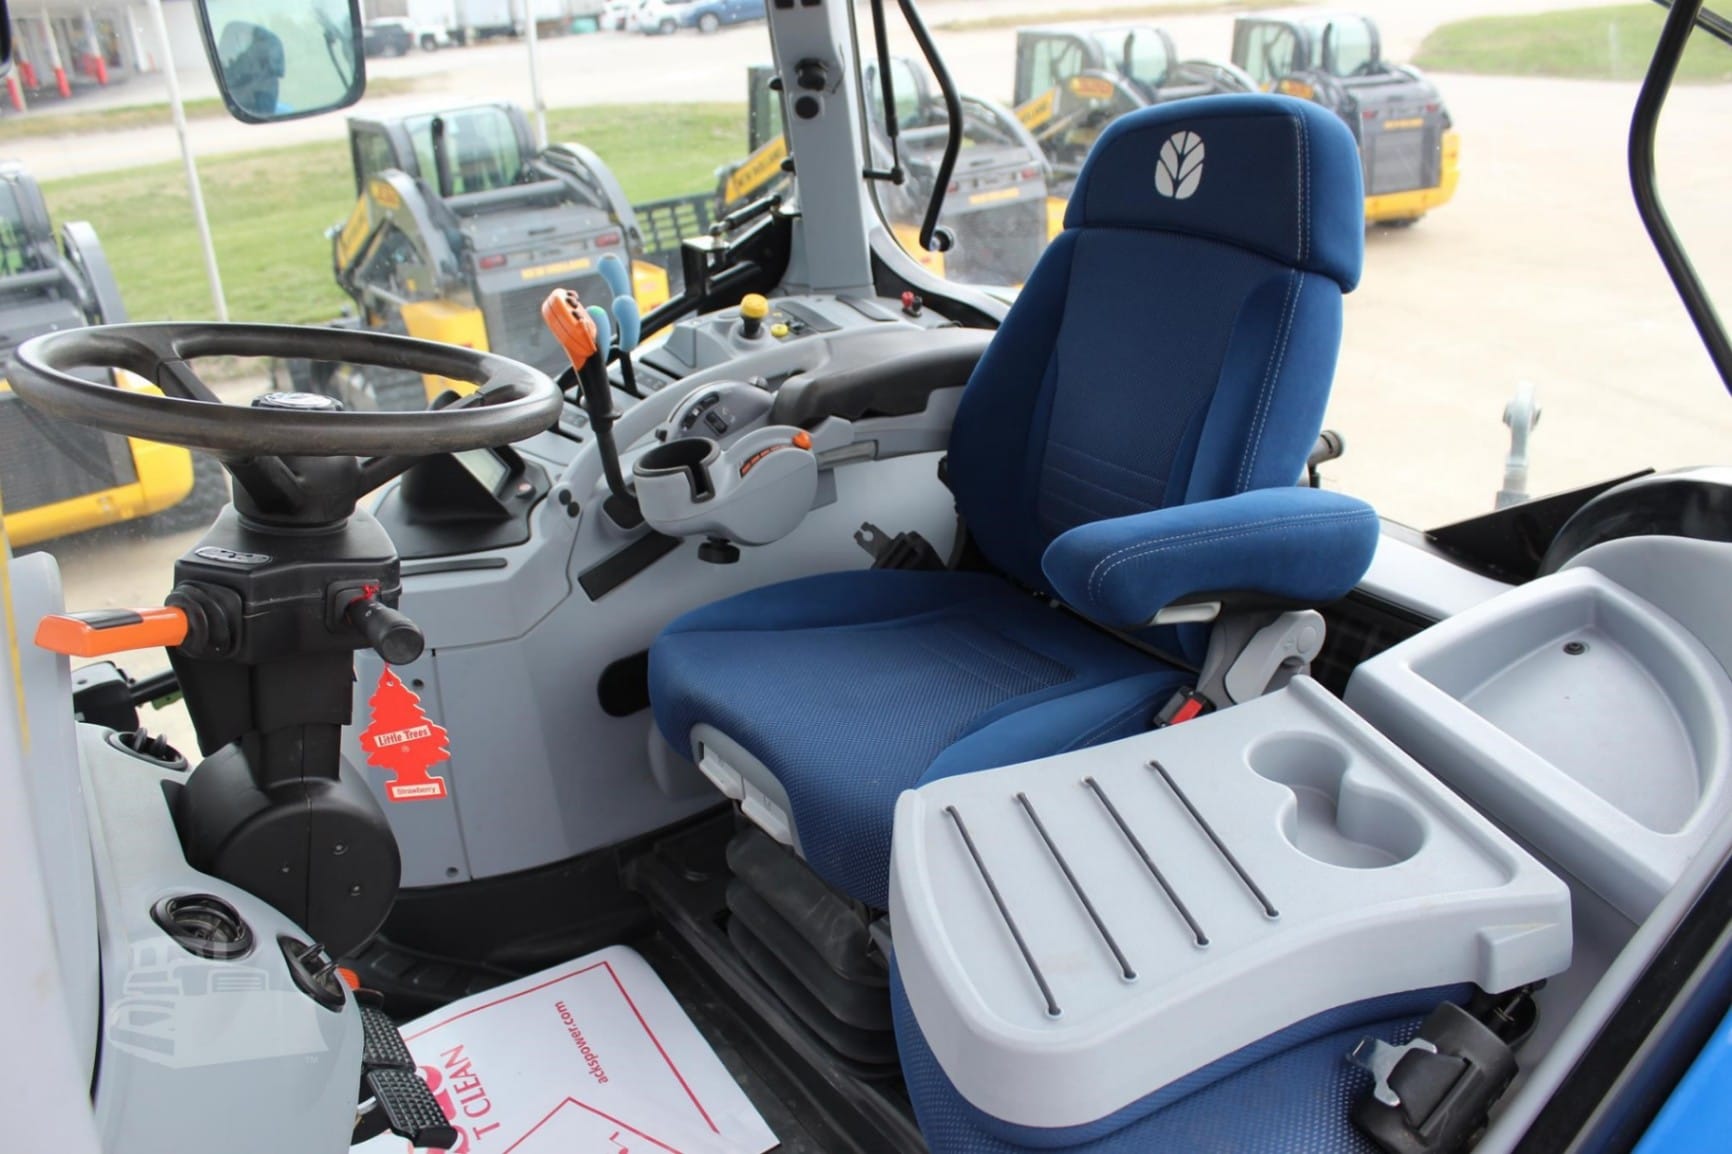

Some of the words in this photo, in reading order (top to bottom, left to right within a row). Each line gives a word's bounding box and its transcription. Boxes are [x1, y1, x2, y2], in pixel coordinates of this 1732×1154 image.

[378, 733, 402, 746] Little
[403, 728, 428, 740] Trees
[555, 1001, 609, 1084] ackspower.com
[439, 1044, 492, 1118] CLEAN
